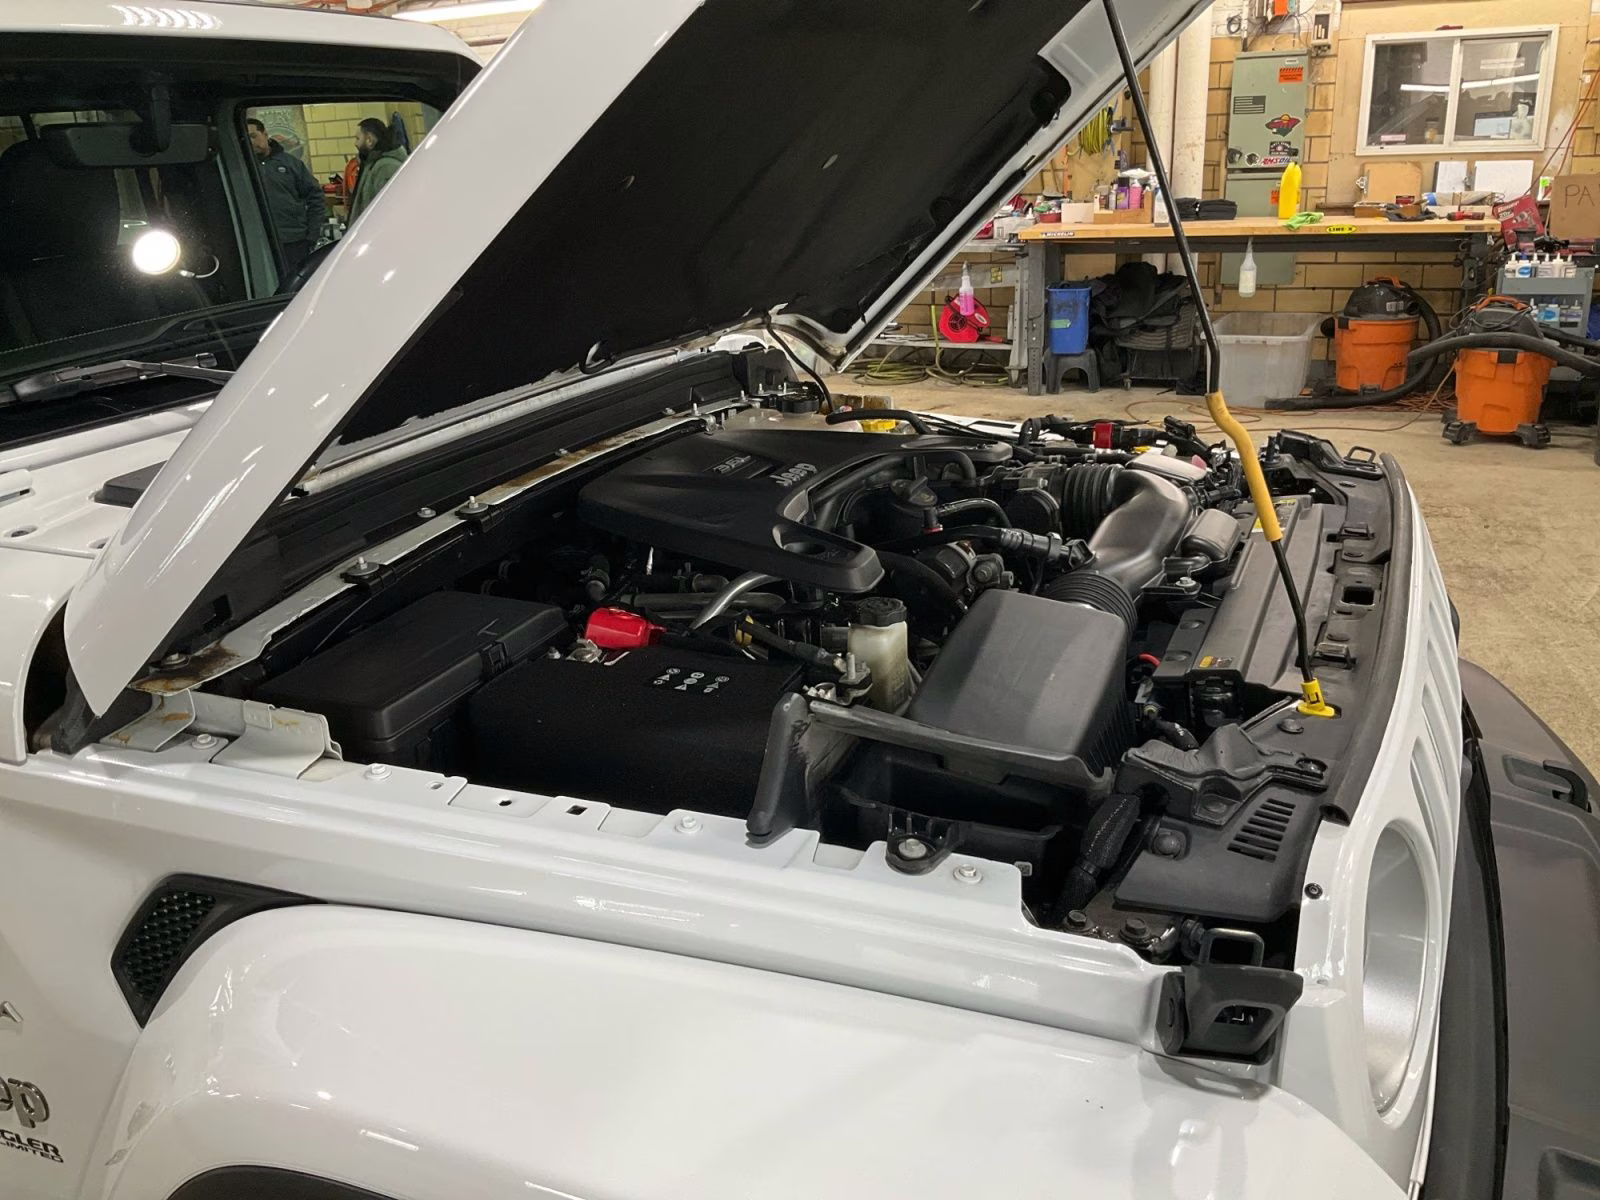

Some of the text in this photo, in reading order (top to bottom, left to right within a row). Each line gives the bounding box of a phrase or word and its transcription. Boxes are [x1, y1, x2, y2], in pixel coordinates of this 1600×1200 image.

[1564, 184, 1600, 208] PA
[769, 463, 817, 487] Jeep
[0, 1129, 62, 1157] GLER
